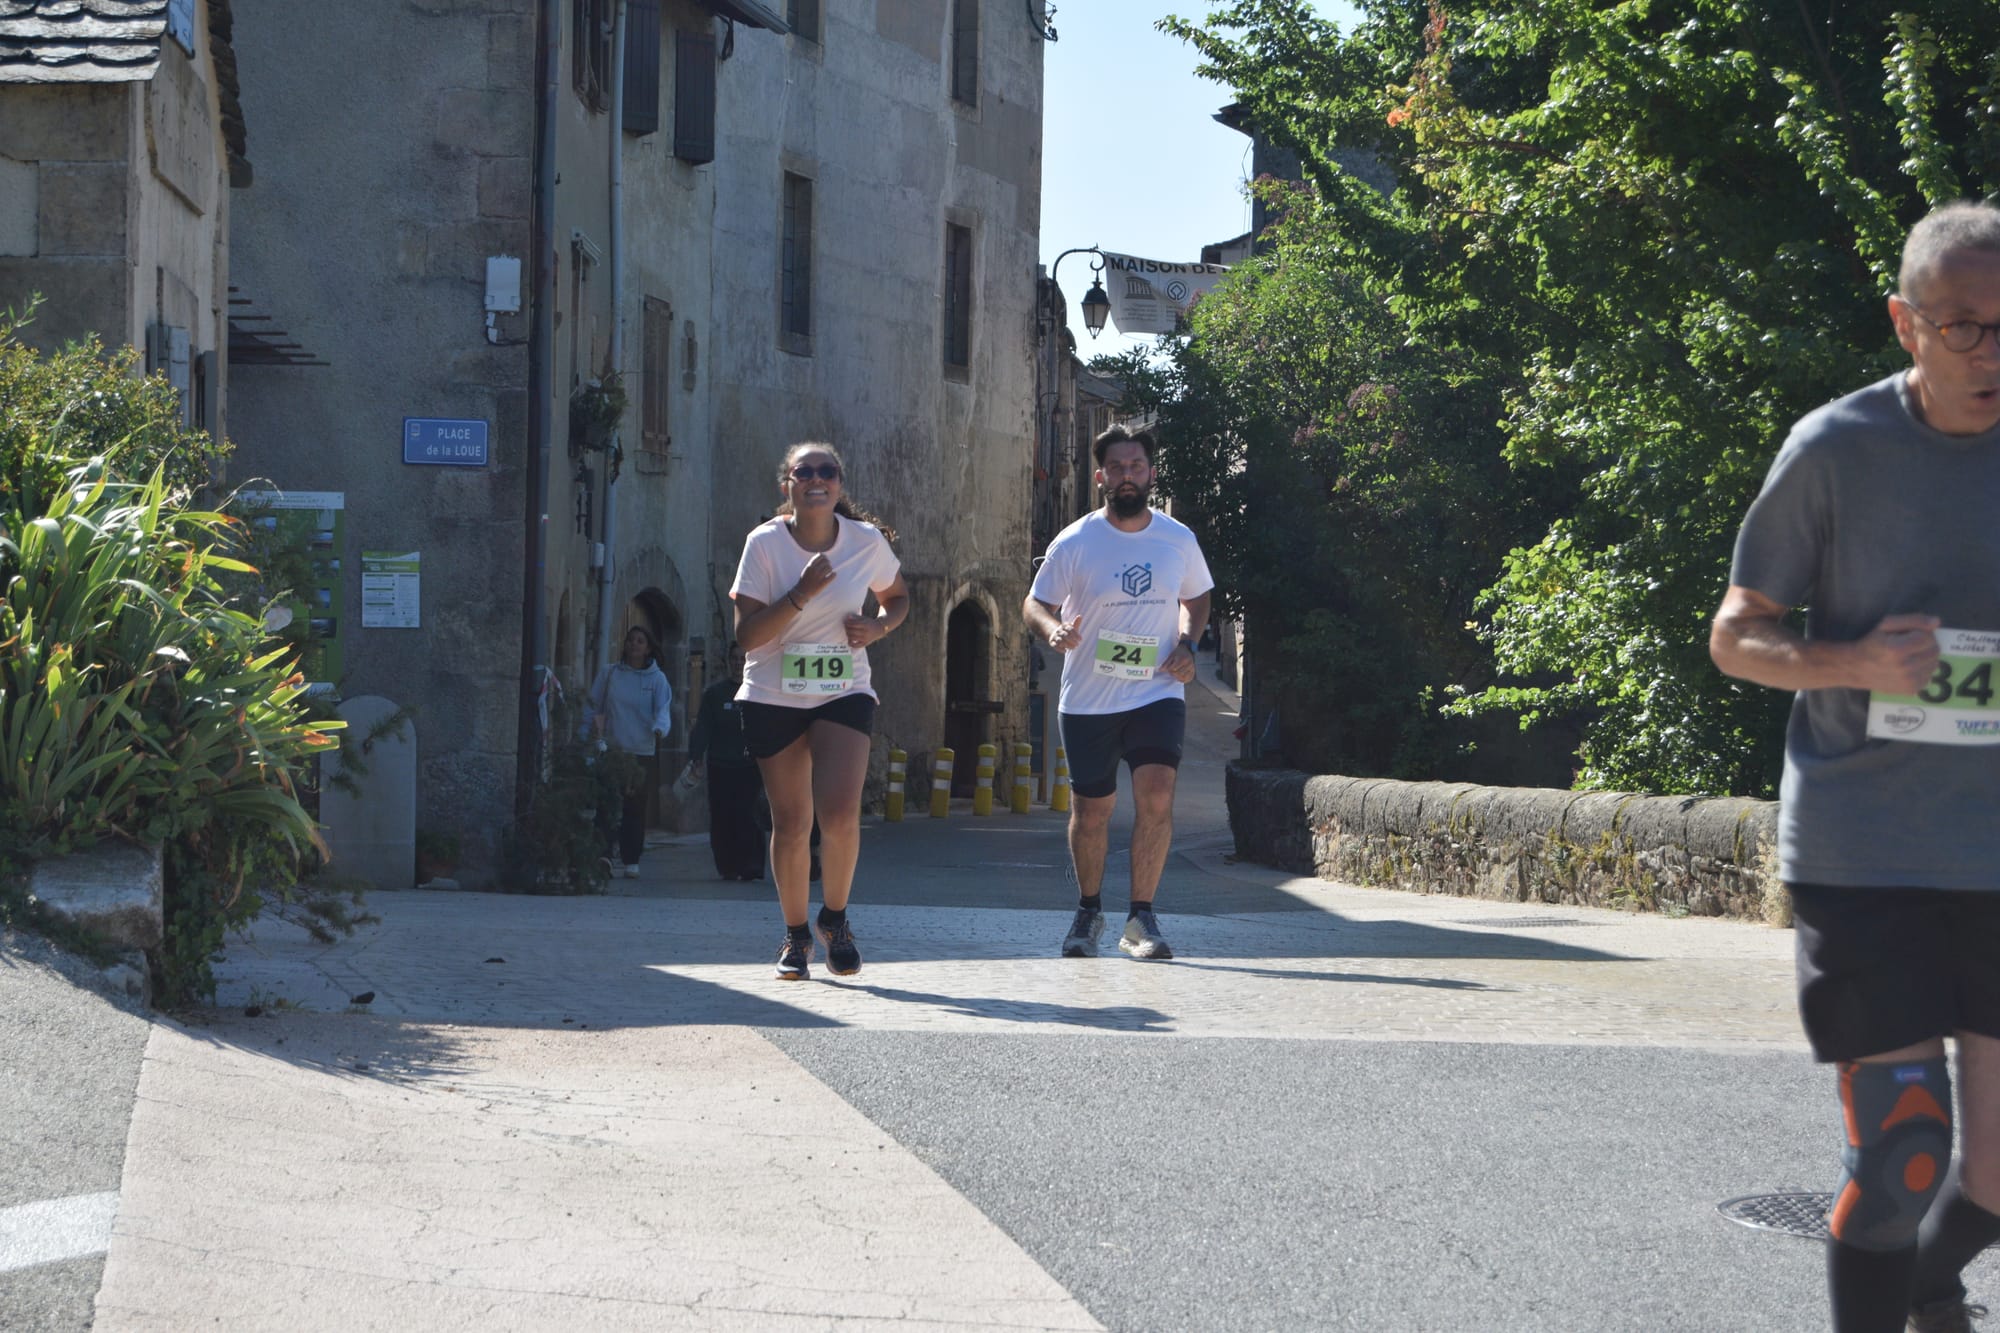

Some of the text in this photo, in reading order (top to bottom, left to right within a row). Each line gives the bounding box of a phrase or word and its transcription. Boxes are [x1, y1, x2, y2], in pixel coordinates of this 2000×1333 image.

[1110, 257, 1186, 273] MAISON
[1192, 264, 1217, 274] DE
[437, 428, 471, 440] PLACE
[426, 444, 481, 457] de la LOUE
[1111, 644, 1142, 665] 24
[793, 657, 844, 678] 119
[1917, 660, 1994, 706] 34
